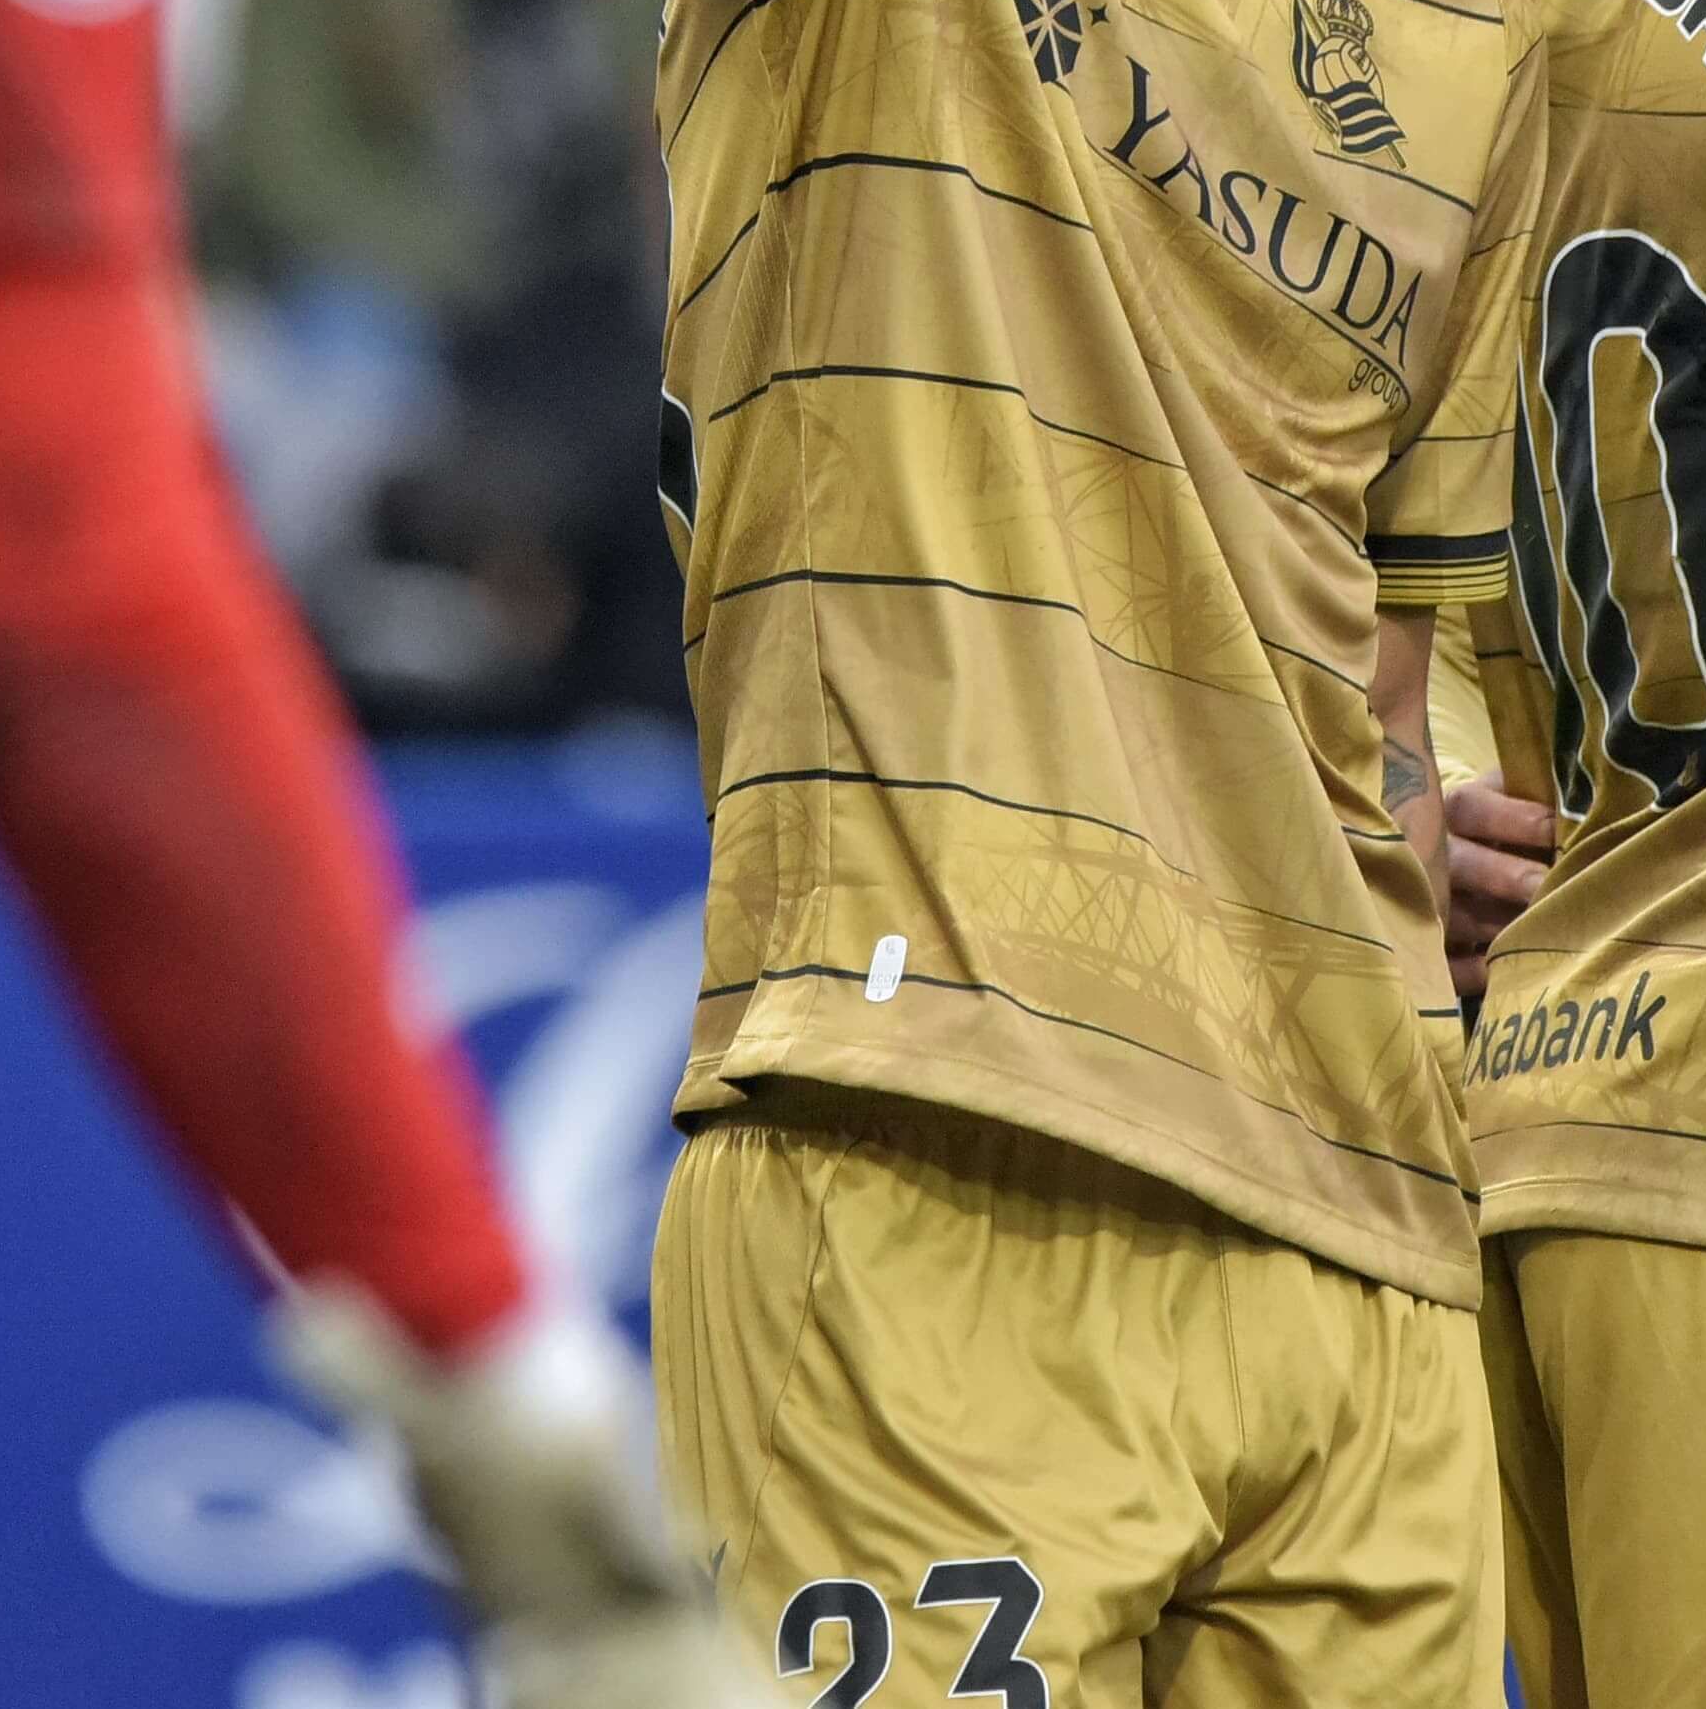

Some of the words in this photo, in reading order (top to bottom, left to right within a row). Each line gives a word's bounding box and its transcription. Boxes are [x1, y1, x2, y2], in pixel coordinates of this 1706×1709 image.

[1103, 55, 1423, 371] YASUDA
[1348, 357, 1402, 412] group
[775, 1556, 1050, 1709] 23
